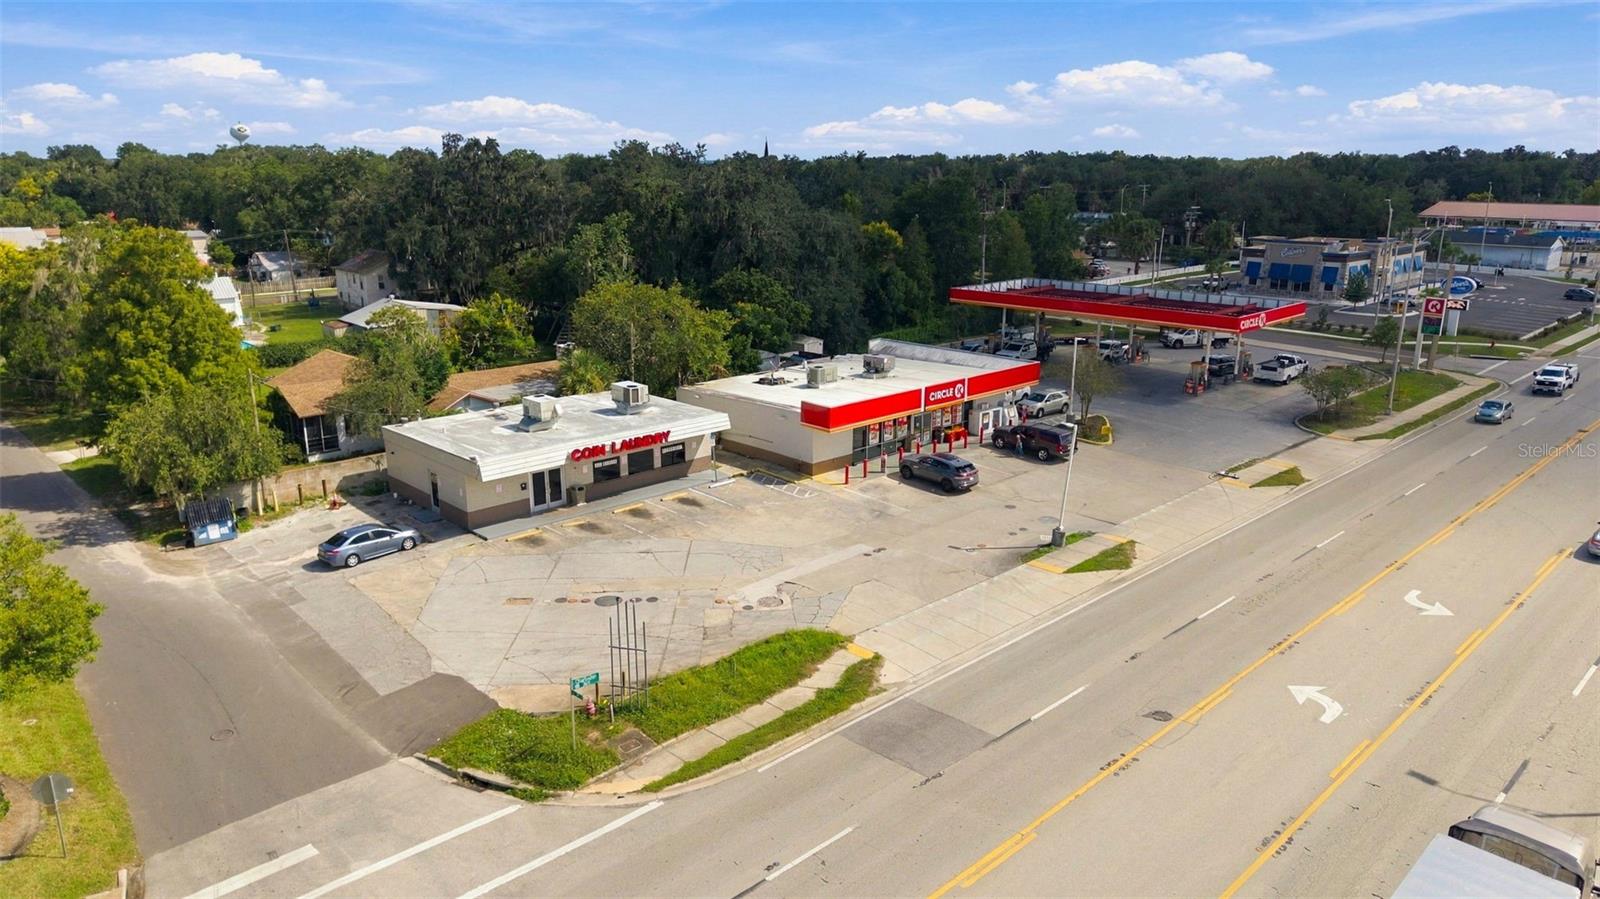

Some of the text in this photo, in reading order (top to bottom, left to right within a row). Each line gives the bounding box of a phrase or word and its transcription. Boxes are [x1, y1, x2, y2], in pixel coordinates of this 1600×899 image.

[1428, 300, 1441, 312] K
[1240, 317, 1259, 330] CIRCLE
[929, 384, 964, 401] CIRCLE K
[571, 444, 606, 462] COIN
[611, 430, 671, 454] LAUNDRY
